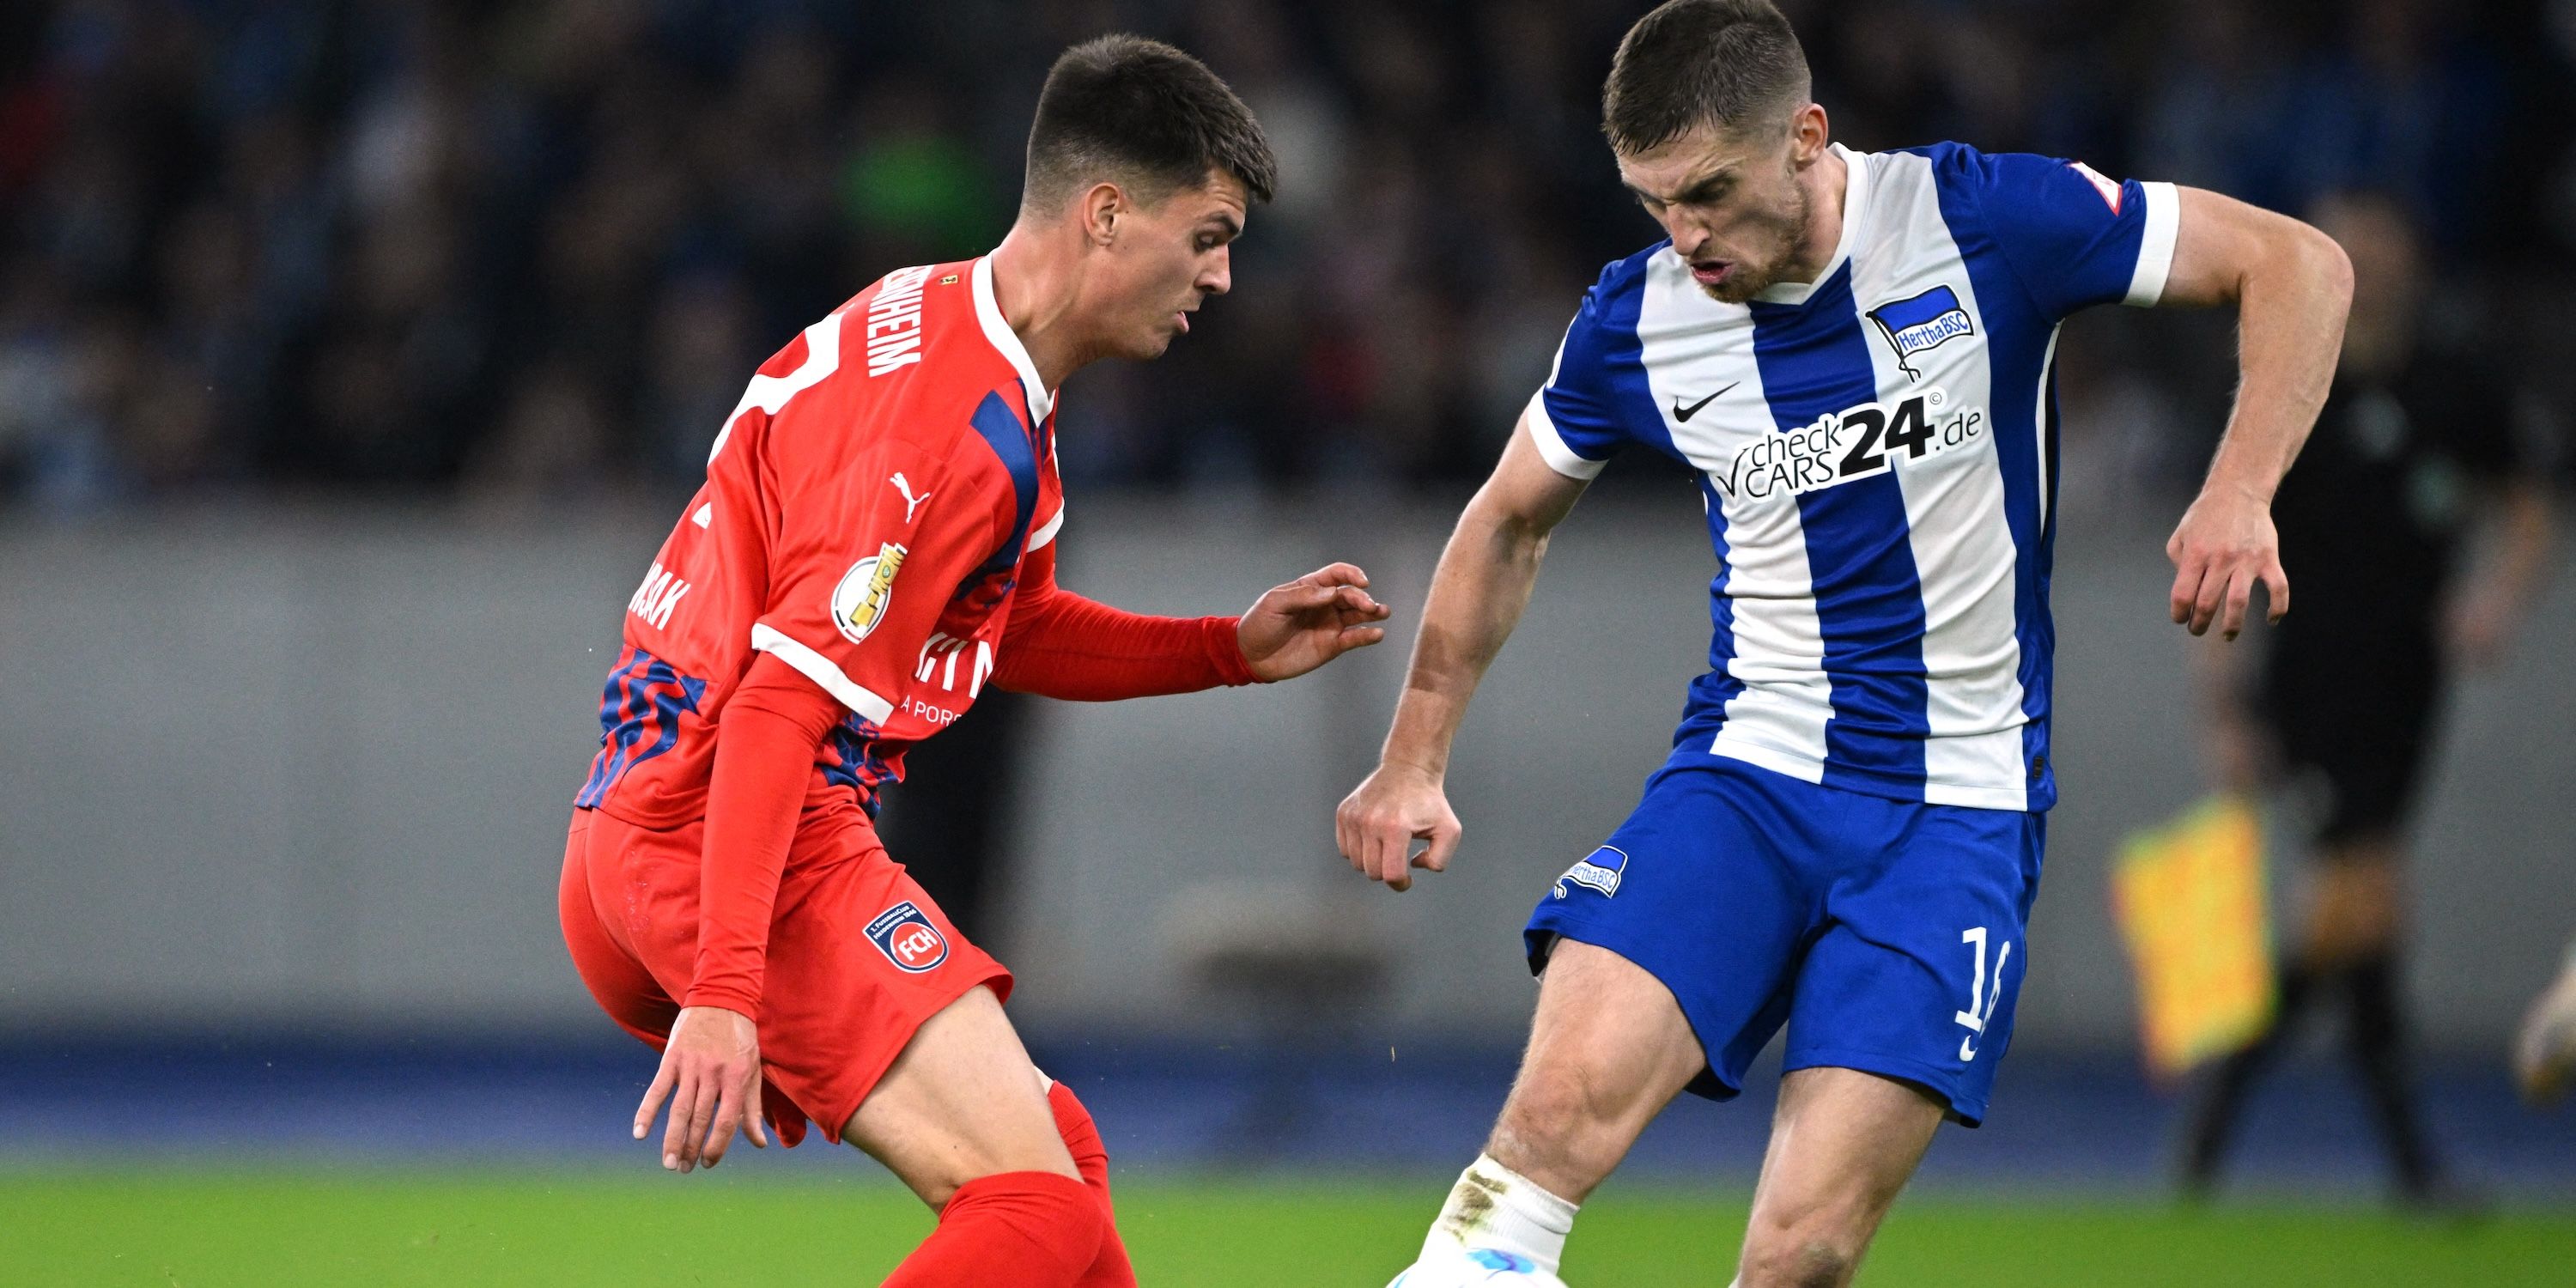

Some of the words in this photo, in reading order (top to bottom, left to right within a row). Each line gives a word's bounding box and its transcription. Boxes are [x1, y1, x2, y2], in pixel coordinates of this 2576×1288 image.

[1752, 420, 1842, 467] check
[1745, 451, 1834, 498] CARS
[900, 694, 911, 714] A
[898, 928, 938, 962] FCH
